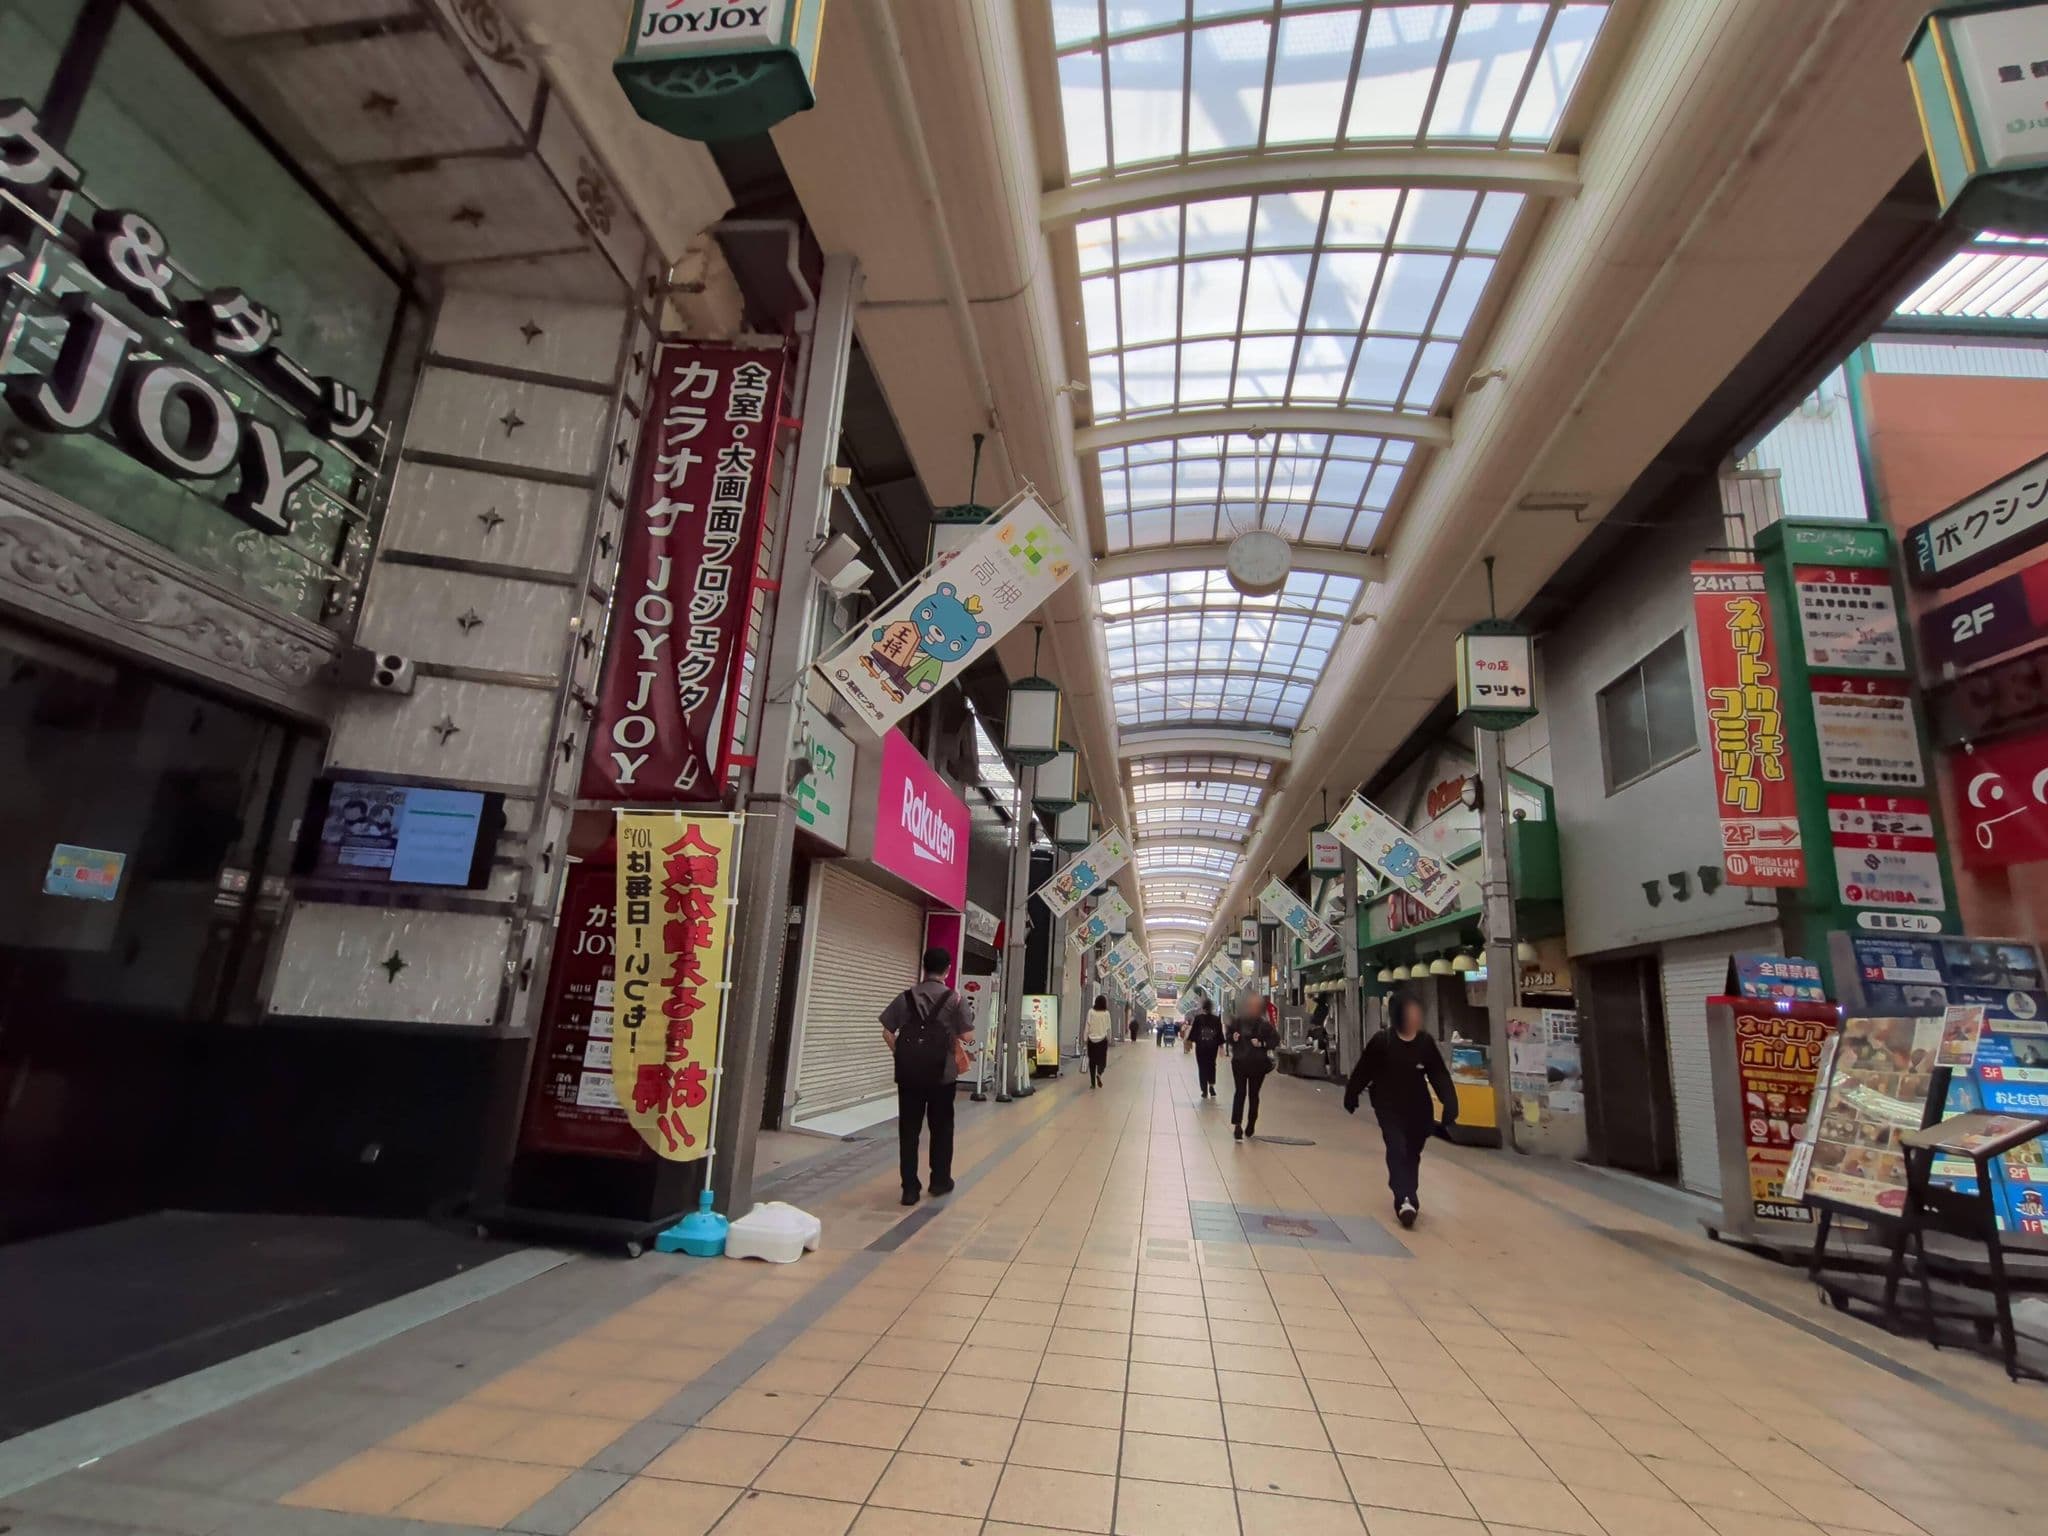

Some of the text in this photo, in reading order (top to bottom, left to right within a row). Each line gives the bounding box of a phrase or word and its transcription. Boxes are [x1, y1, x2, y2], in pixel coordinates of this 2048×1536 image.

[642, 6, 767, 37] JOYJOY
[38, 303, 321, 528] JOY
[675, 361, 770, 790] 全室・大画面プロジェクタ!
[1951, 603, 1995, 643] 2F
[882, 626, 913, 660] 王将
[1475, 659, 1509, 672] 中の店
[1475, 684, 1526, 697] マツヤ
[901, 776, 955, 865] Rakuten
[1723, 824, 1755, 845] 2F
[1737, 1017, 1830, 1042] ネットカフ
[1743, 1039, 1820, 1069] ポパ
[1982, 1067, 2000, 1079] 3F
[2021, 1219, 2040, 1232] 1F
